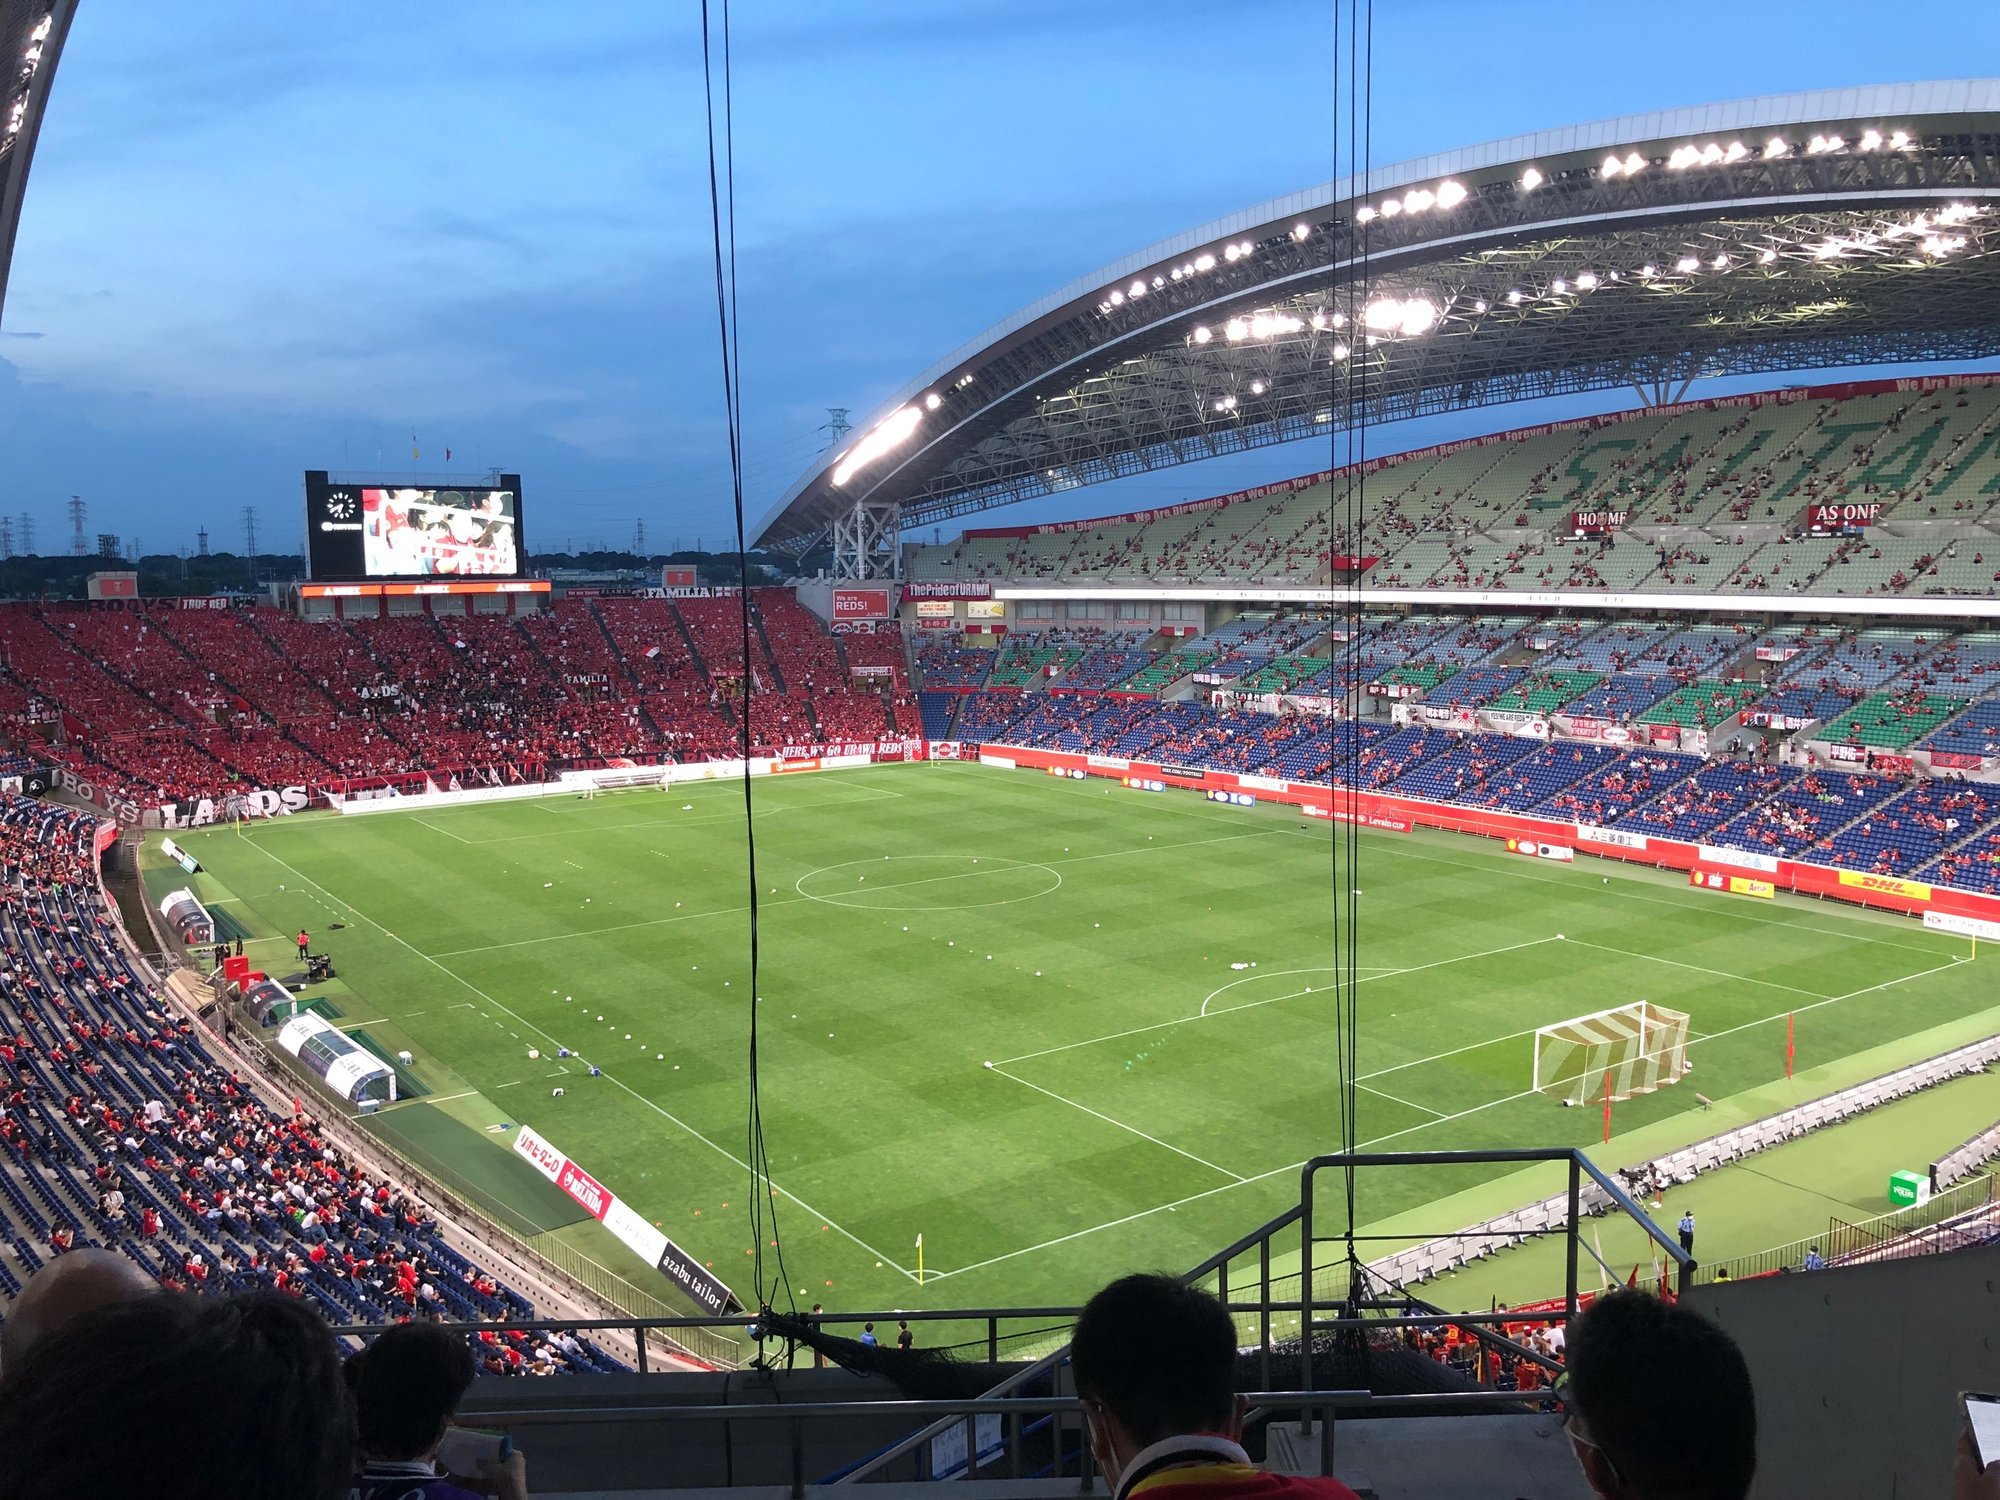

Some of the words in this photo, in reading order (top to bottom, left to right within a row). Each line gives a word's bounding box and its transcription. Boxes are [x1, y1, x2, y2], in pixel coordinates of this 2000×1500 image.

[1816, 505, 1838, 520] AS
[647, 587, 711, 599] FAMILIA
[836, 601, 868, 611] REDS!
[566, 675, 608, 684] FAMILIA
[782, 745, 808, 759] HERE
[827, 745, 841, 757] GO
[879, 742, 904, 755] REDS
[1392, 821, 1406, 829] CUP
[1861, 876, 1906, 894] DHL
[662, 1255, 691, 1284] azabu
[691, 1276, 721, 1309] tailor
